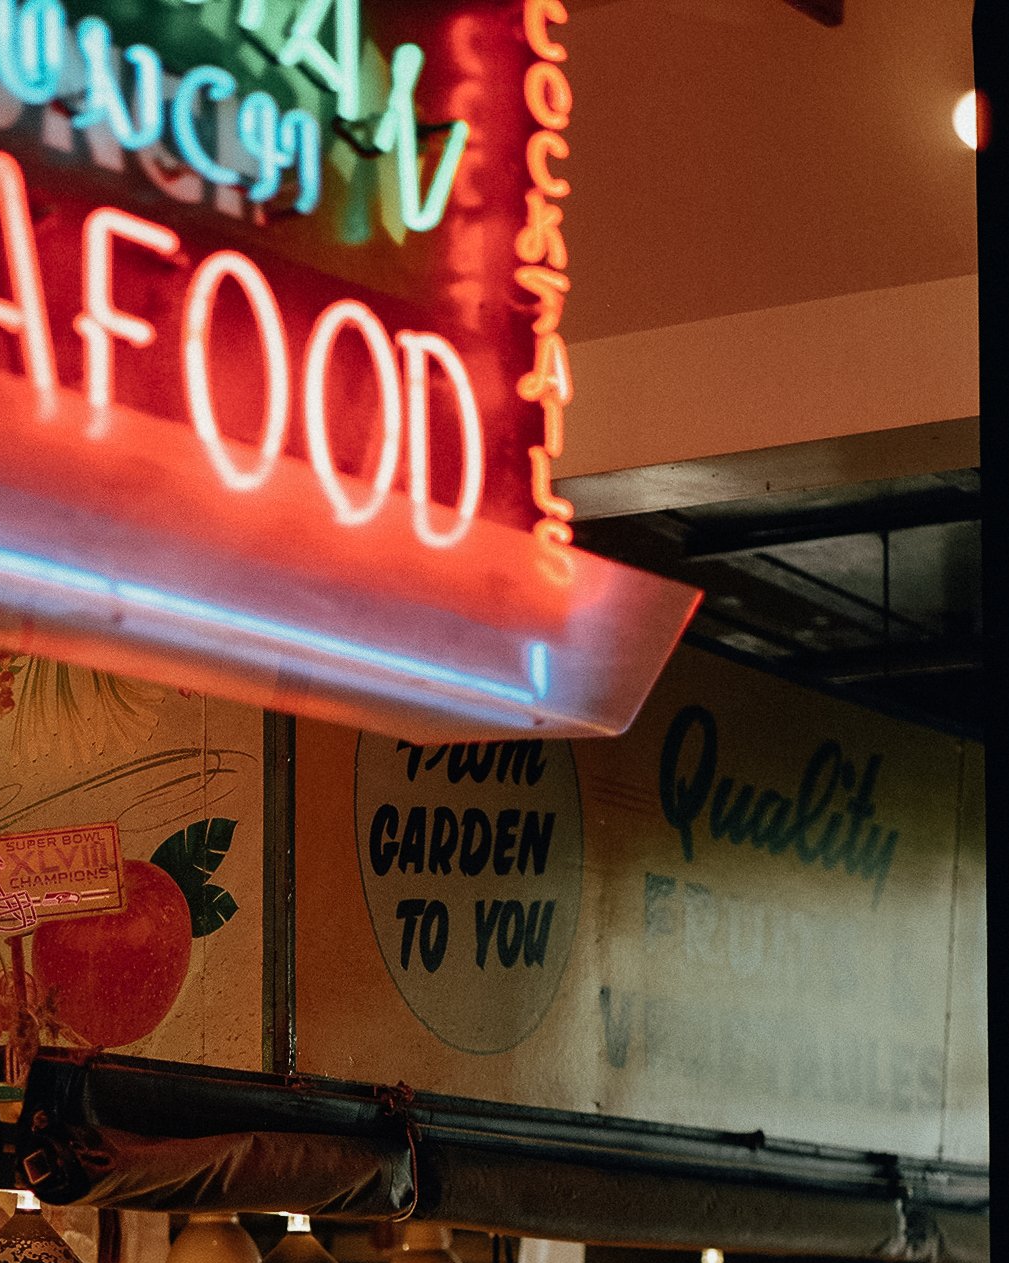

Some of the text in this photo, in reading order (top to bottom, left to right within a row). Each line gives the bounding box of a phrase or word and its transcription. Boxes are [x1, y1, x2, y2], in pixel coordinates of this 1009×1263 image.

[239, 0, 470, 232] AN
[6, 831, 105, 852] SUPER BOWL
[369, 804, 556, 877] GARDEN
[659, 705, 899, 911] Quality
[10, 867, 110, 889] CHAMPIONS
[396, 899, 556, 973] TO YOU
